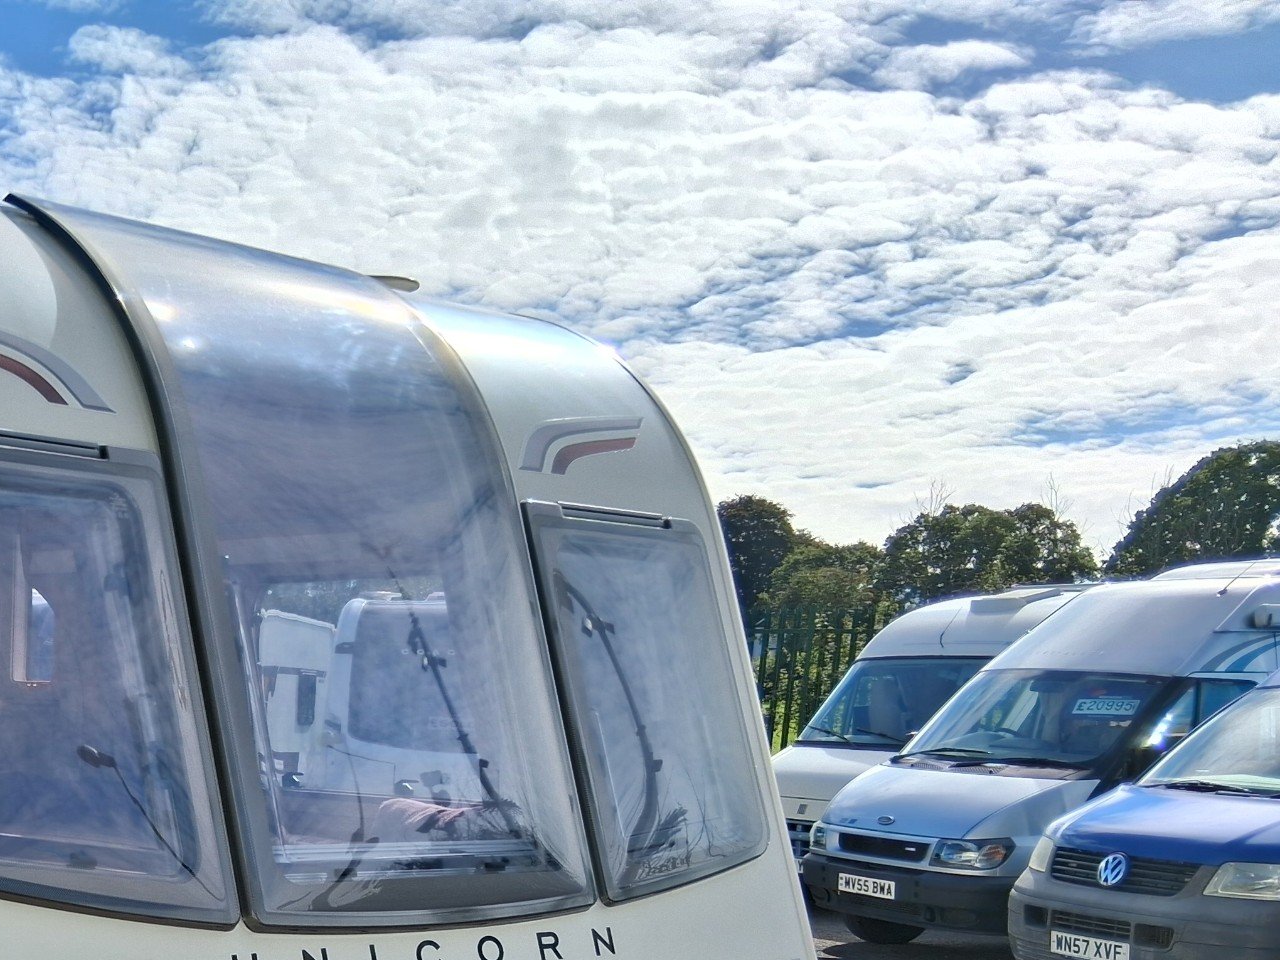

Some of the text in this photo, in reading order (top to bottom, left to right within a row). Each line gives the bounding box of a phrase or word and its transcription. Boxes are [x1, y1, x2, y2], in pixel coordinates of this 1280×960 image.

[845, 879, 893, 897] MV55 BWA
[1056, 934, 1123, 960] WN57 XVF
